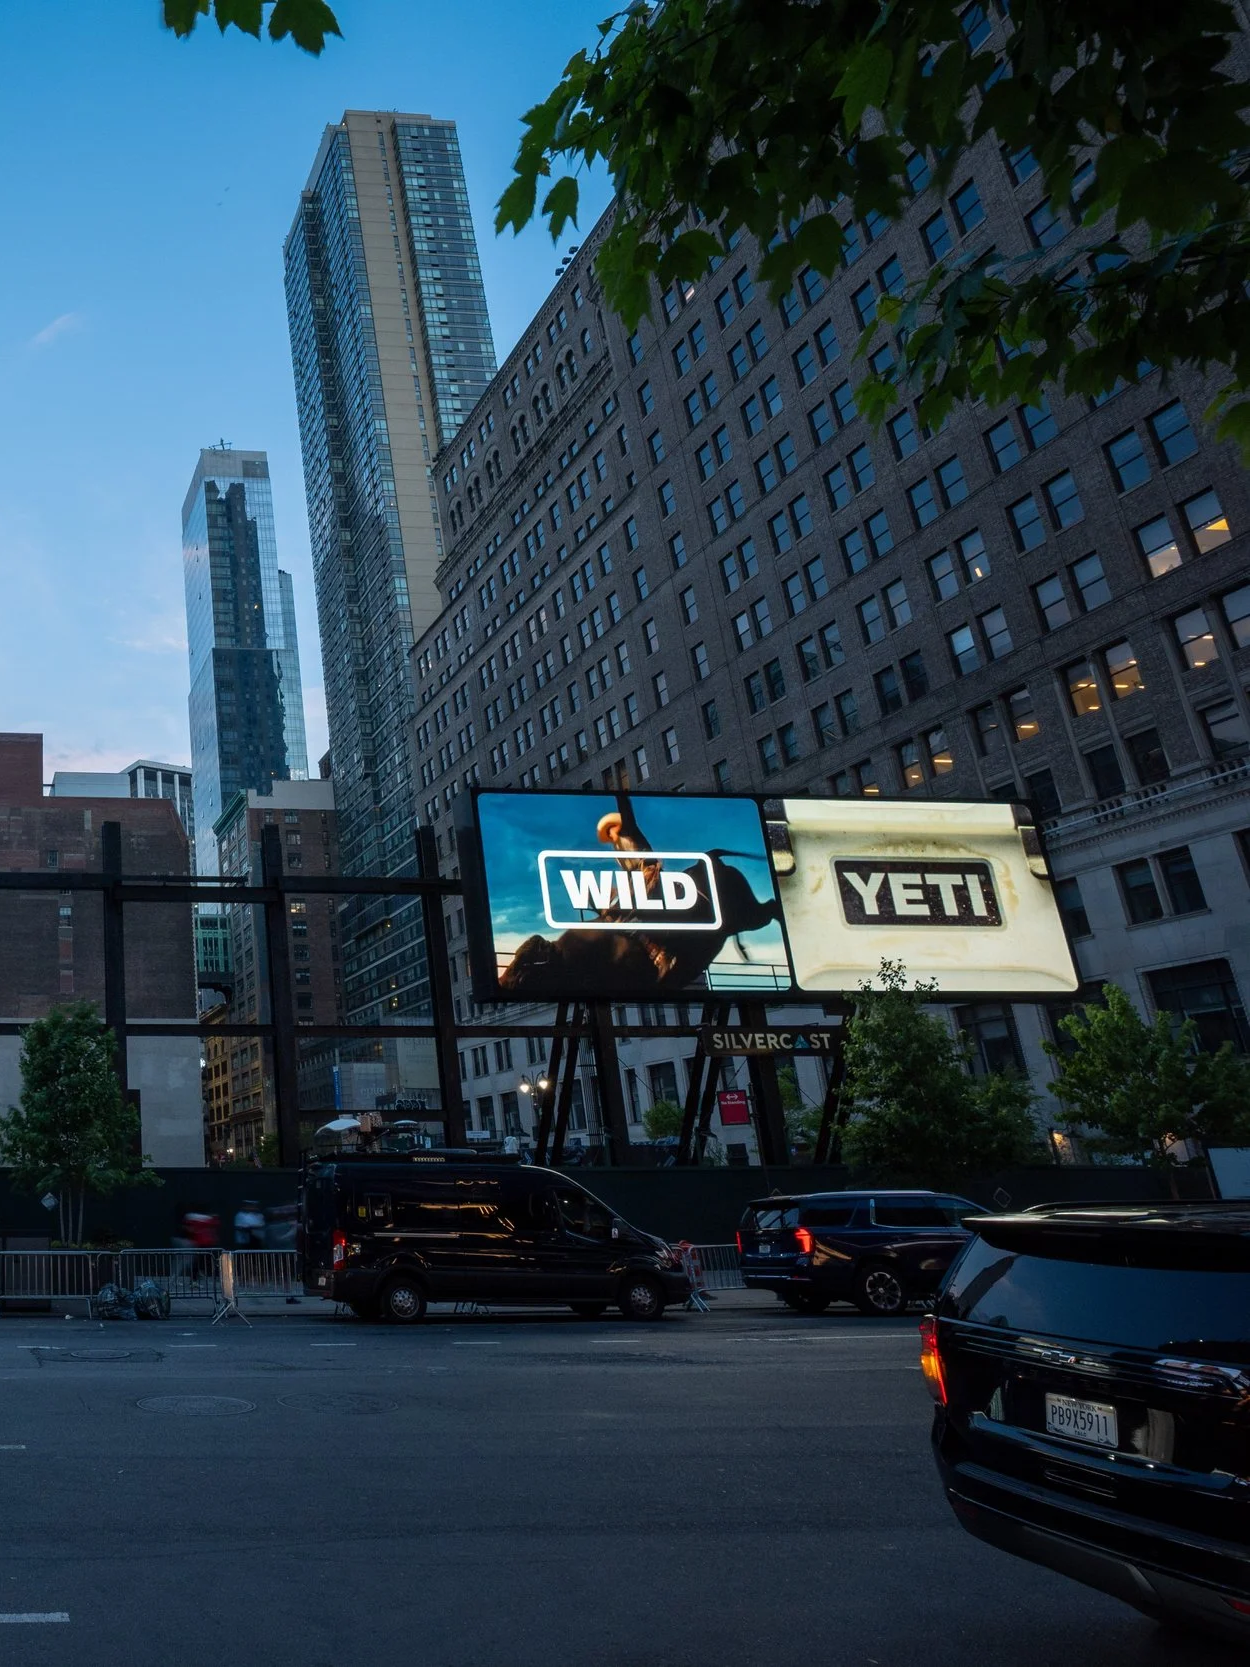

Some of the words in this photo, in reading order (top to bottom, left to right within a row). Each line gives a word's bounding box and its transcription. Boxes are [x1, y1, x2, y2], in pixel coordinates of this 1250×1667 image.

[560, 869, 699, 911] WILD
[844, 872, 990, 916] YETI
[1050, 1404, 1108, 1436] PB9X5911
[1061, 1399, 1079, 1408] NEW
[1078, 1402, 1097, 1413] YORK
